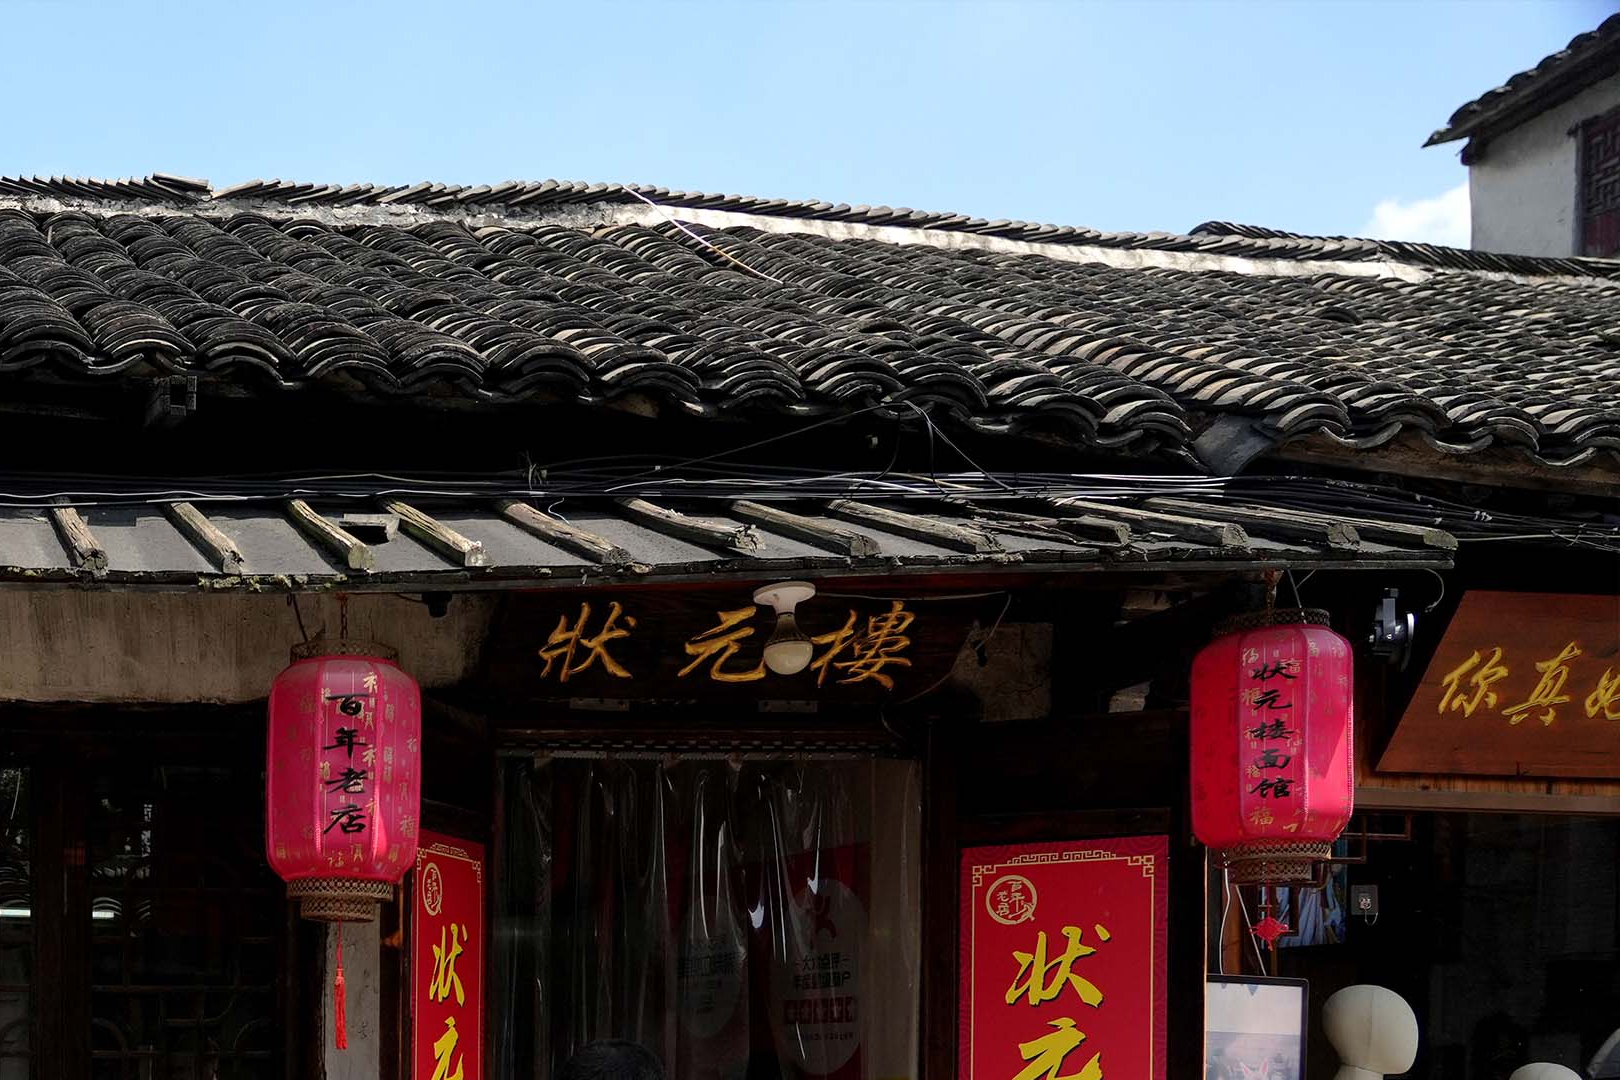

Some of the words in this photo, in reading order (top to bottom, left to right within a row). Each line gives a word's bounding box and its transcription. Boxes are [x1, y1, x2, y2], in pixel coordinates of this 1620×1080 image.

[323, 692, 369, 835] 百年老店
[1249, 661, 1299, 799] 状元楼面馆
